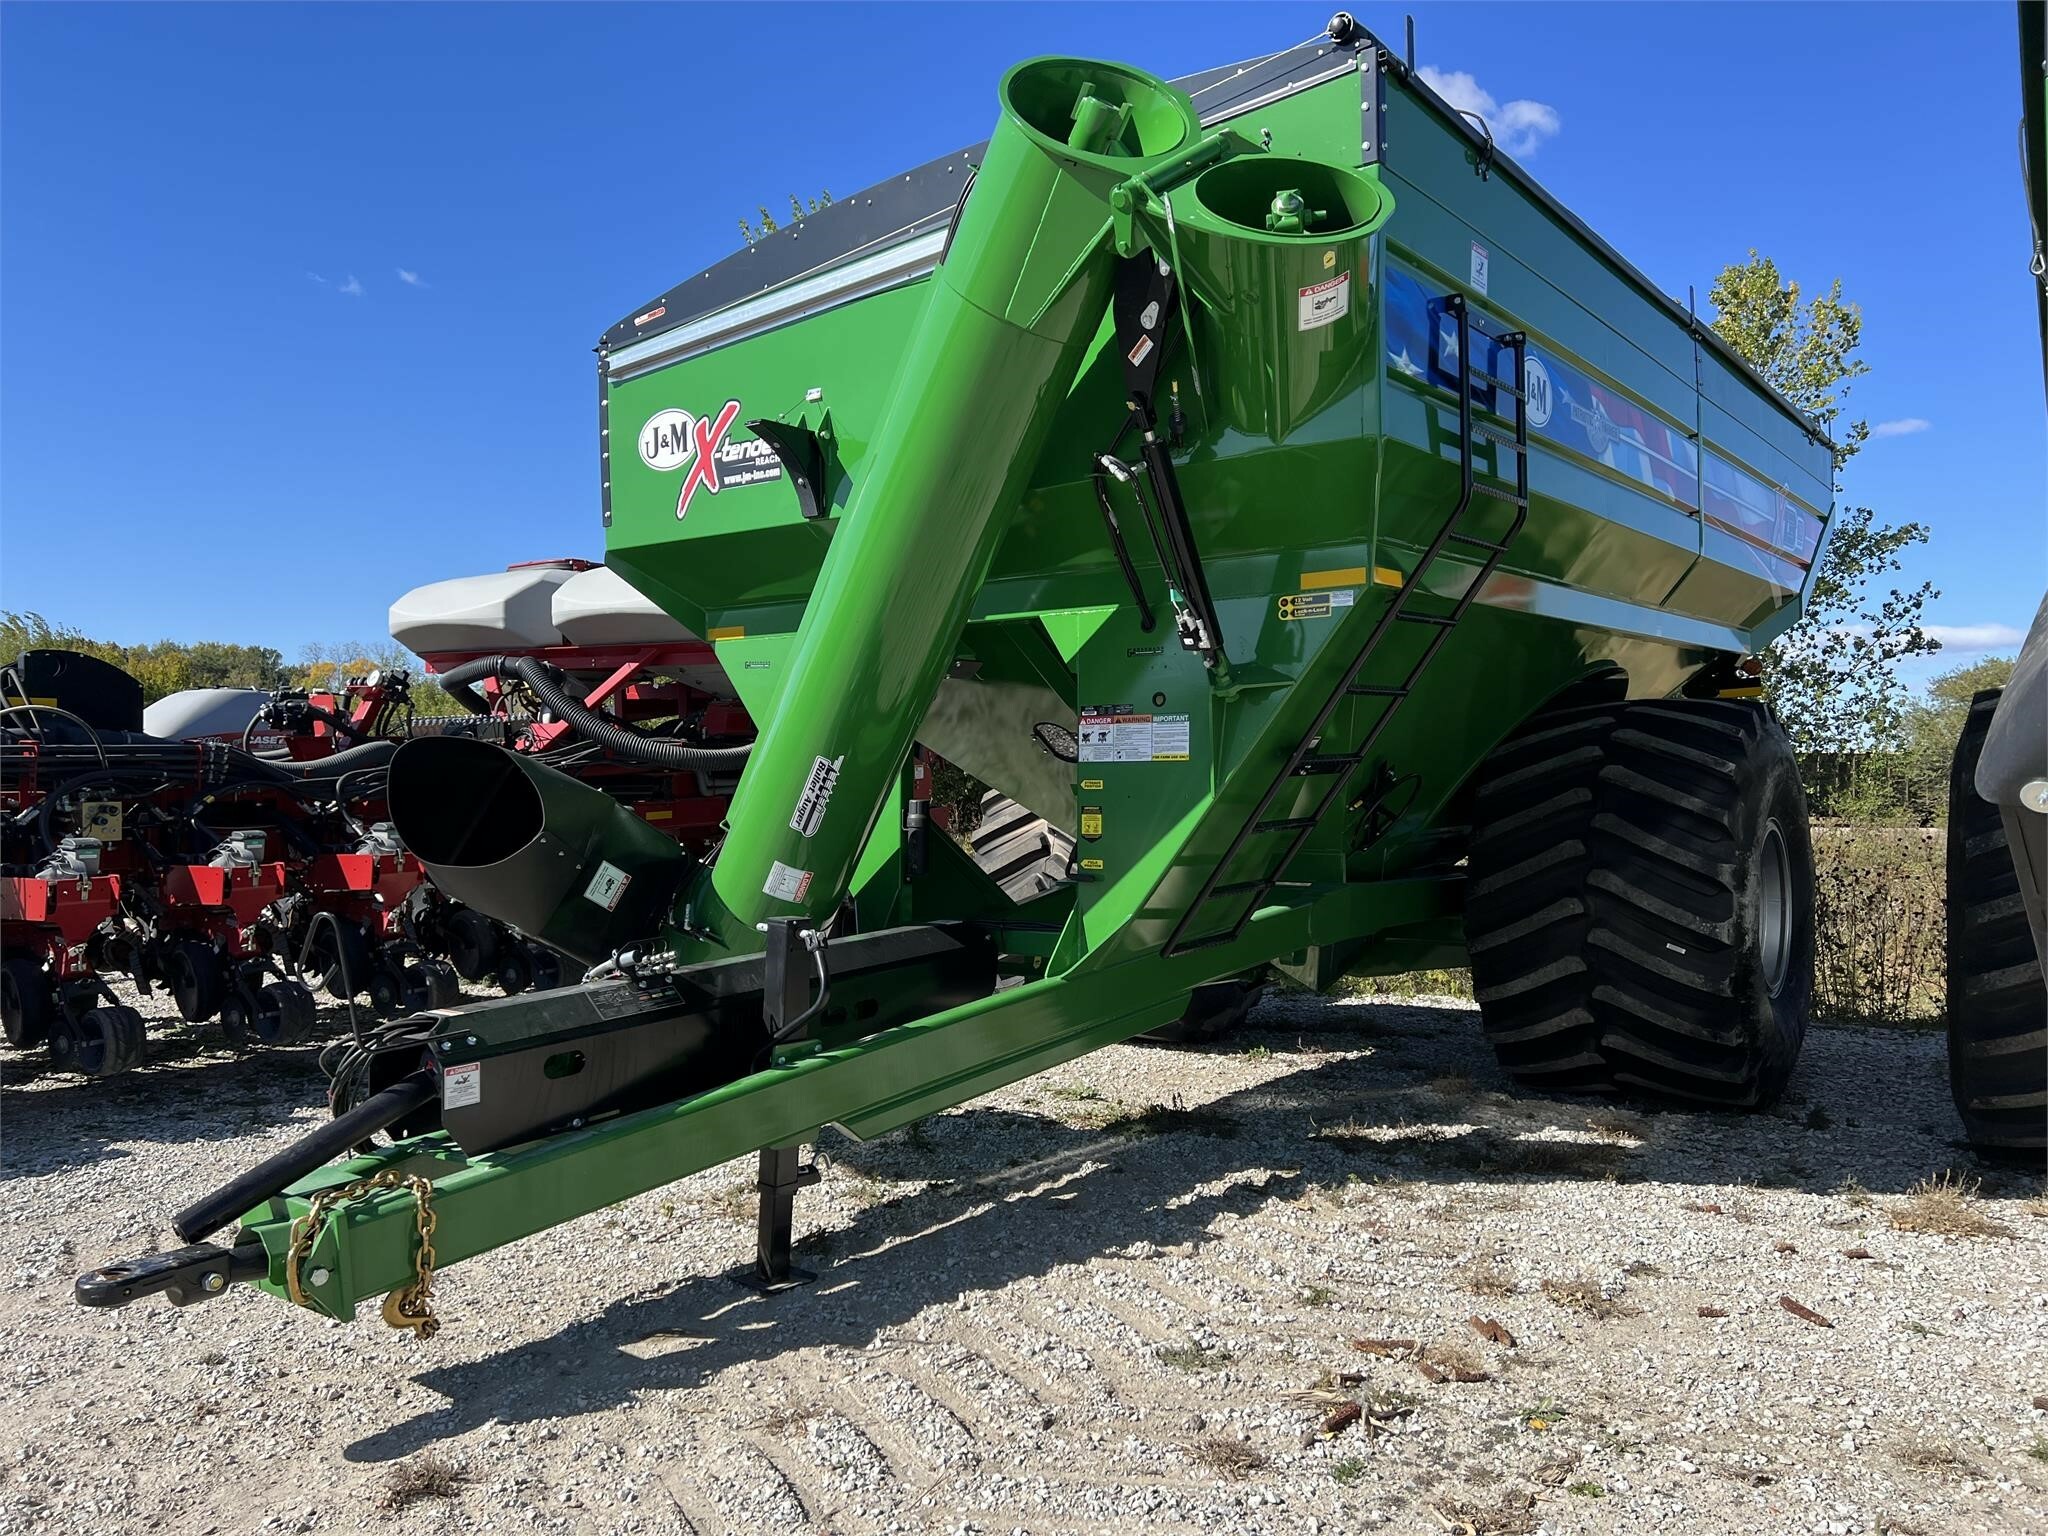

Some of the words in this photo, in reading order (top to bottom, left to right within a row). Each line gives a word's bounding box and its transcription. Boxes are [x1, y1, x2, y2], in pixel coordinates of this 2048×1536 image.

[1314, 275, 1345, 293] DANGER
[1526, 370, 1547, 415] J&M
[645, 421, 688, 459] J&M
[676, 399, 776, 521] X-tende
[755, 454, 780, 466] REACH
[1086, 717, 1112, 725] DANGER
[808, 760, 827, 793] Bullet
[795, 795, 813, 828] Auger
